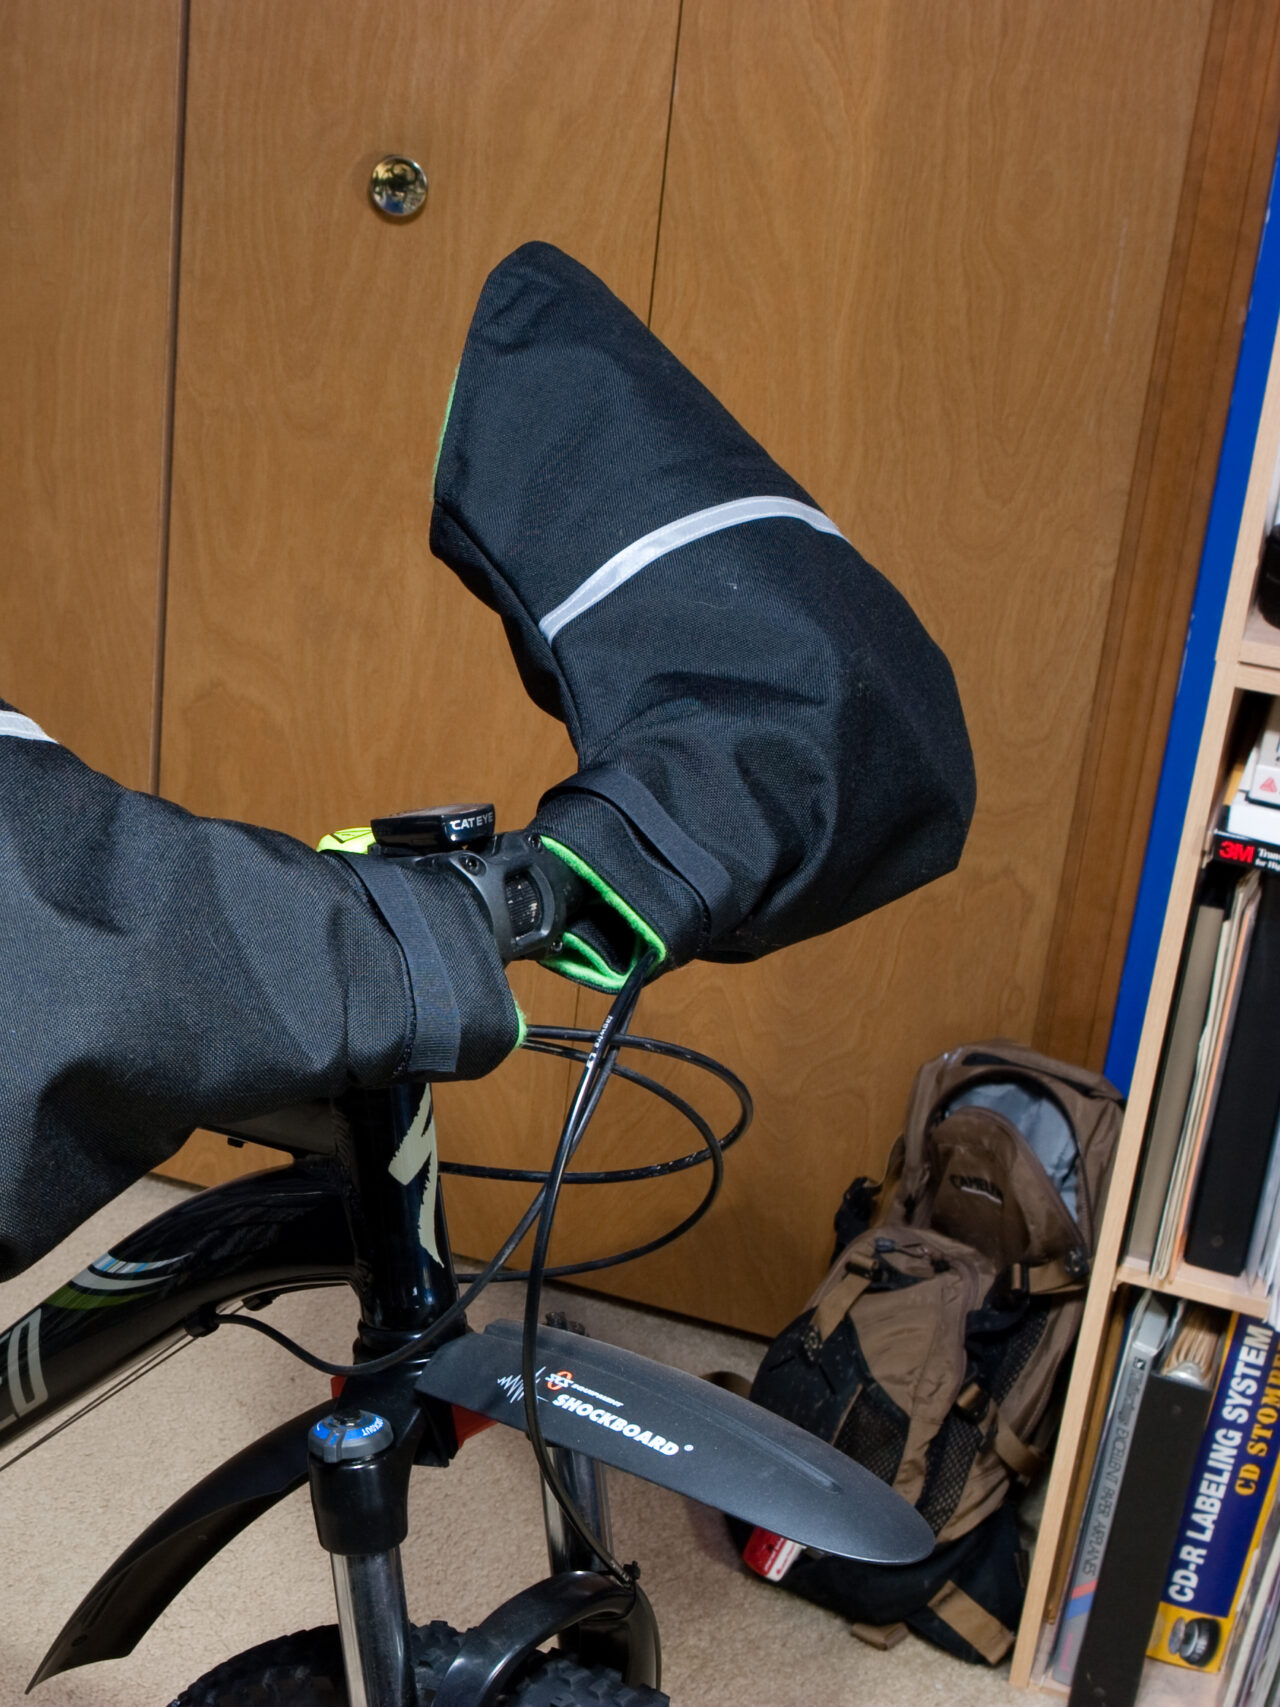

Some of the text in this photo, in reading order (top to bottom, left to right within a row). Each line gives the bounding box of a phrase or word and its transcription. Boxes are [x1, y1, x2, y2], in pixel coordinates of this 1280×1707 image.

[449, 811, 494, 830] CATEYE
[1218, 841, 1256, 864] 3M
[551, 1393, 680, 1456] SHOCKBOARD
[1167, 1324, 1273, 1604] CD-R LABELING SYSTEM
[1234, 1463, 1261, 1497] CD
